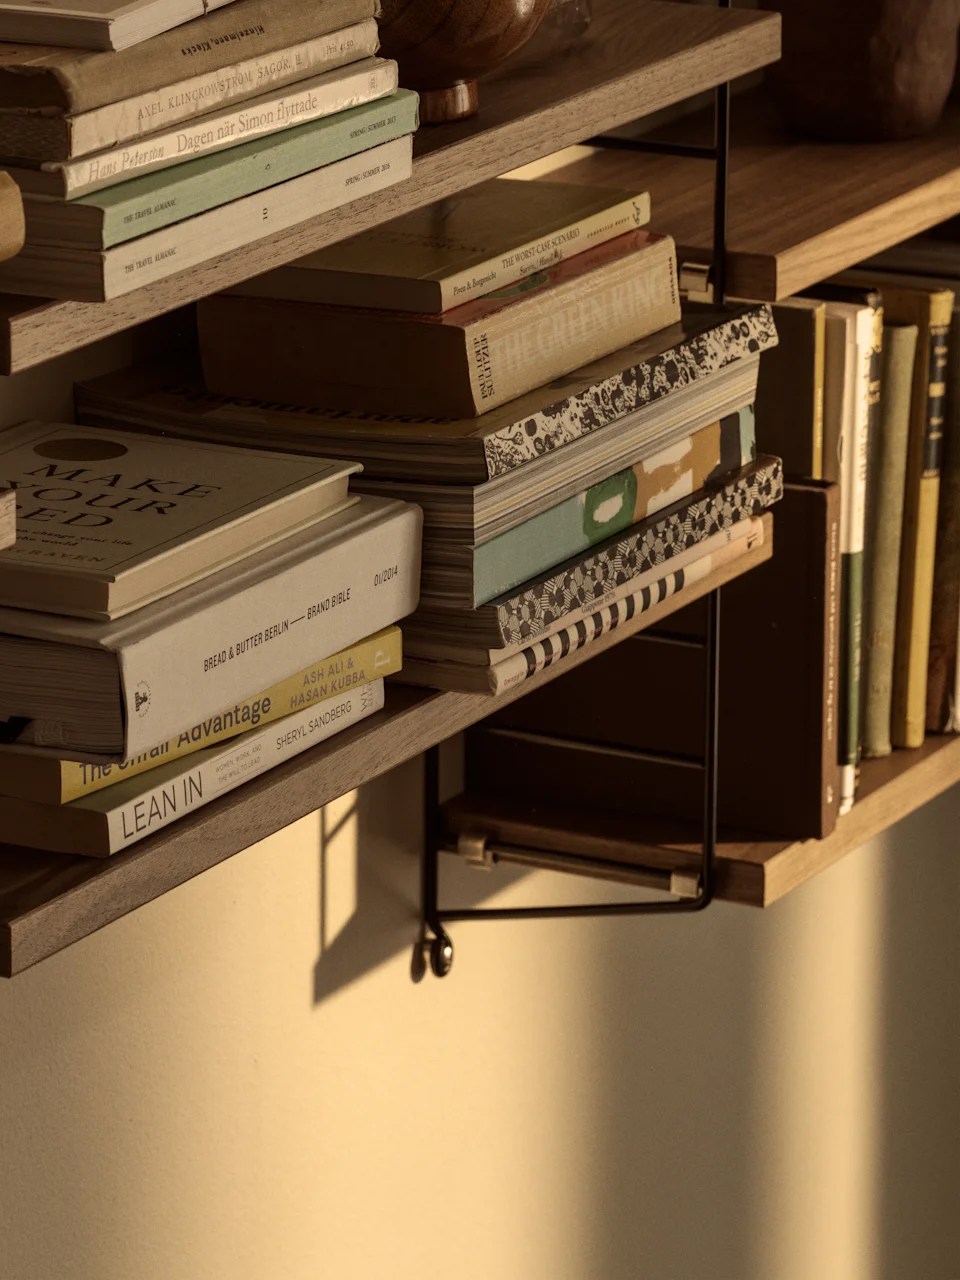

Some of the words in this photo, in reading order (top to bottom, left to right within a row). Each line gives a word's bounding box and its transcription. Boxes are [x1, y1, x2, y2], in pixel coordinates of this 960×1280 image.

[325, 43, 338, 55] Pris
[136, 100, 165, 121] AXEL
[88, 160, 118, 183] Hans
[121, 144, 165, 172] Peterson
[176, 129, 215, 155] Dagen
[217, 120, 236, 141] när
[238, 111, 275, 134] Simon
[276, 93, 319, 124] flyttade
[123, 214, 134, 224] THE
[134, 206, 153, 221] TRAVEL
[154, 198, 177, 213] ALMANAC
[124, 264, 135, 274] THE
[135, 257, 153, 270] TRAVEL
[154, 246, 177, 263] ALMANAC
[501, 257, 515, 269] THE
[514, 238, 552, 264] WORST-CASE
[551, 227, 581, 249] SCENARIO
[537, 290, 611, 358] GREEN
[612, 268, 667, 324] KING
[5, 479, 178, 516] YOUR
[22, 463, 223, 499] MAKE
[15, 504, 115, 528] ED
[373, 564, 399, 587] 01/2014
[203, 650, 227, 672] BREAD
[228, 646, 235, 660] &
[236, 631, 263, 656] BUTTER
[264, 618, 290, 642] BERLIN
[307, 597, 330, 620] BRAND
[331, 587, 351, 608] BIBLE
[290, 684, 328, 709] HASAN
[330, 669, 366, 694] KUBBA
[302, 668, 325, 687] ASH
[327, 659, 344, 677] ALI
[347, 657, 354, 669] &
[276, 724, 308, 751] SHERYL
[308, 699, 353, 733] SANDBERG
[248, 756, 262, 770] LEAD
[121, 784, 177, 840] LEAN
[182, 770, 204, 807] IN
